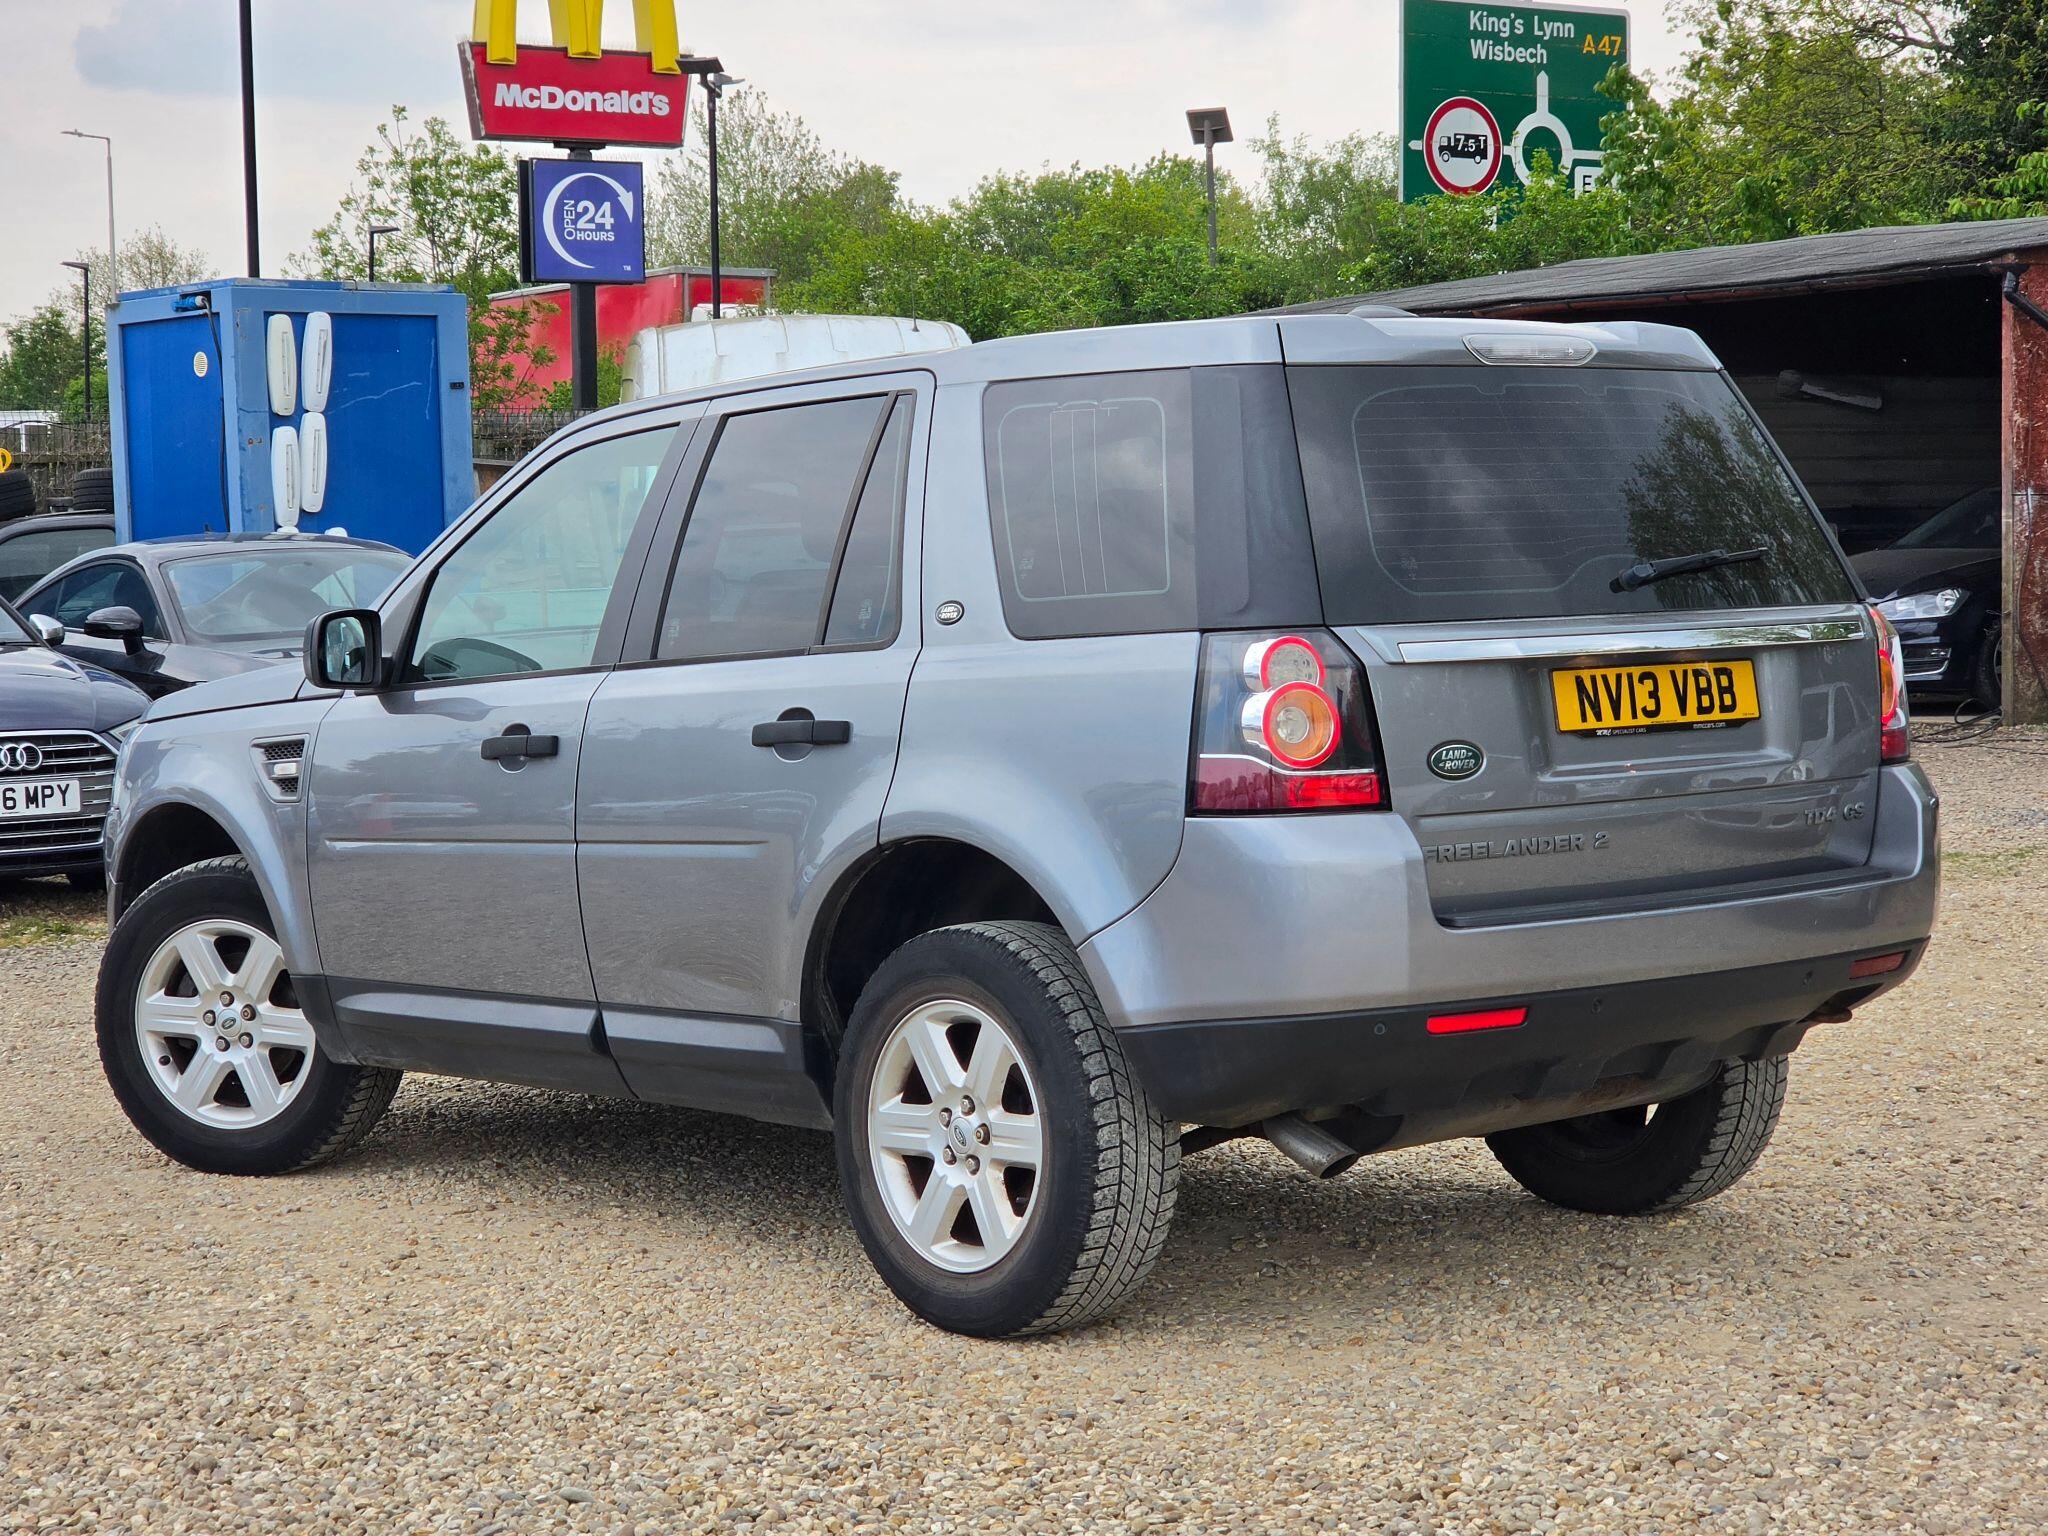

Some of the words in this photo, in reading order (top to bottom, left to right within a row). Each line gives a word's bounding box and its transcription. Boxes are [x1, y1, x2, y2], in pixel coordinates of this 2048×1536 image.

[1469, 10, 1524, 38] King's
[1533, 15, 1575, 39] Lynn
[1470, 39, 1547, 64] Wisbech
[1582, 34, 1622, 56] A47
[494, 83, 670, 116] McDonald's
[563, 200, 576, 240] OPEN
[576, 200, 614, 230] 24
[576, 231, 615, 242] HOURS
[1574, 671, 1662, 723] NV13
[1670, 667, 1737, 716] VBB
[1441, 749, 1467, 760] LAND
[1444, 759, 1475, 770] ROVER
[24, 783, 70, 809] MPY
[1422, 833, 1585, 863] FREELANDER
[1594, 831, 1609, 849] 2
